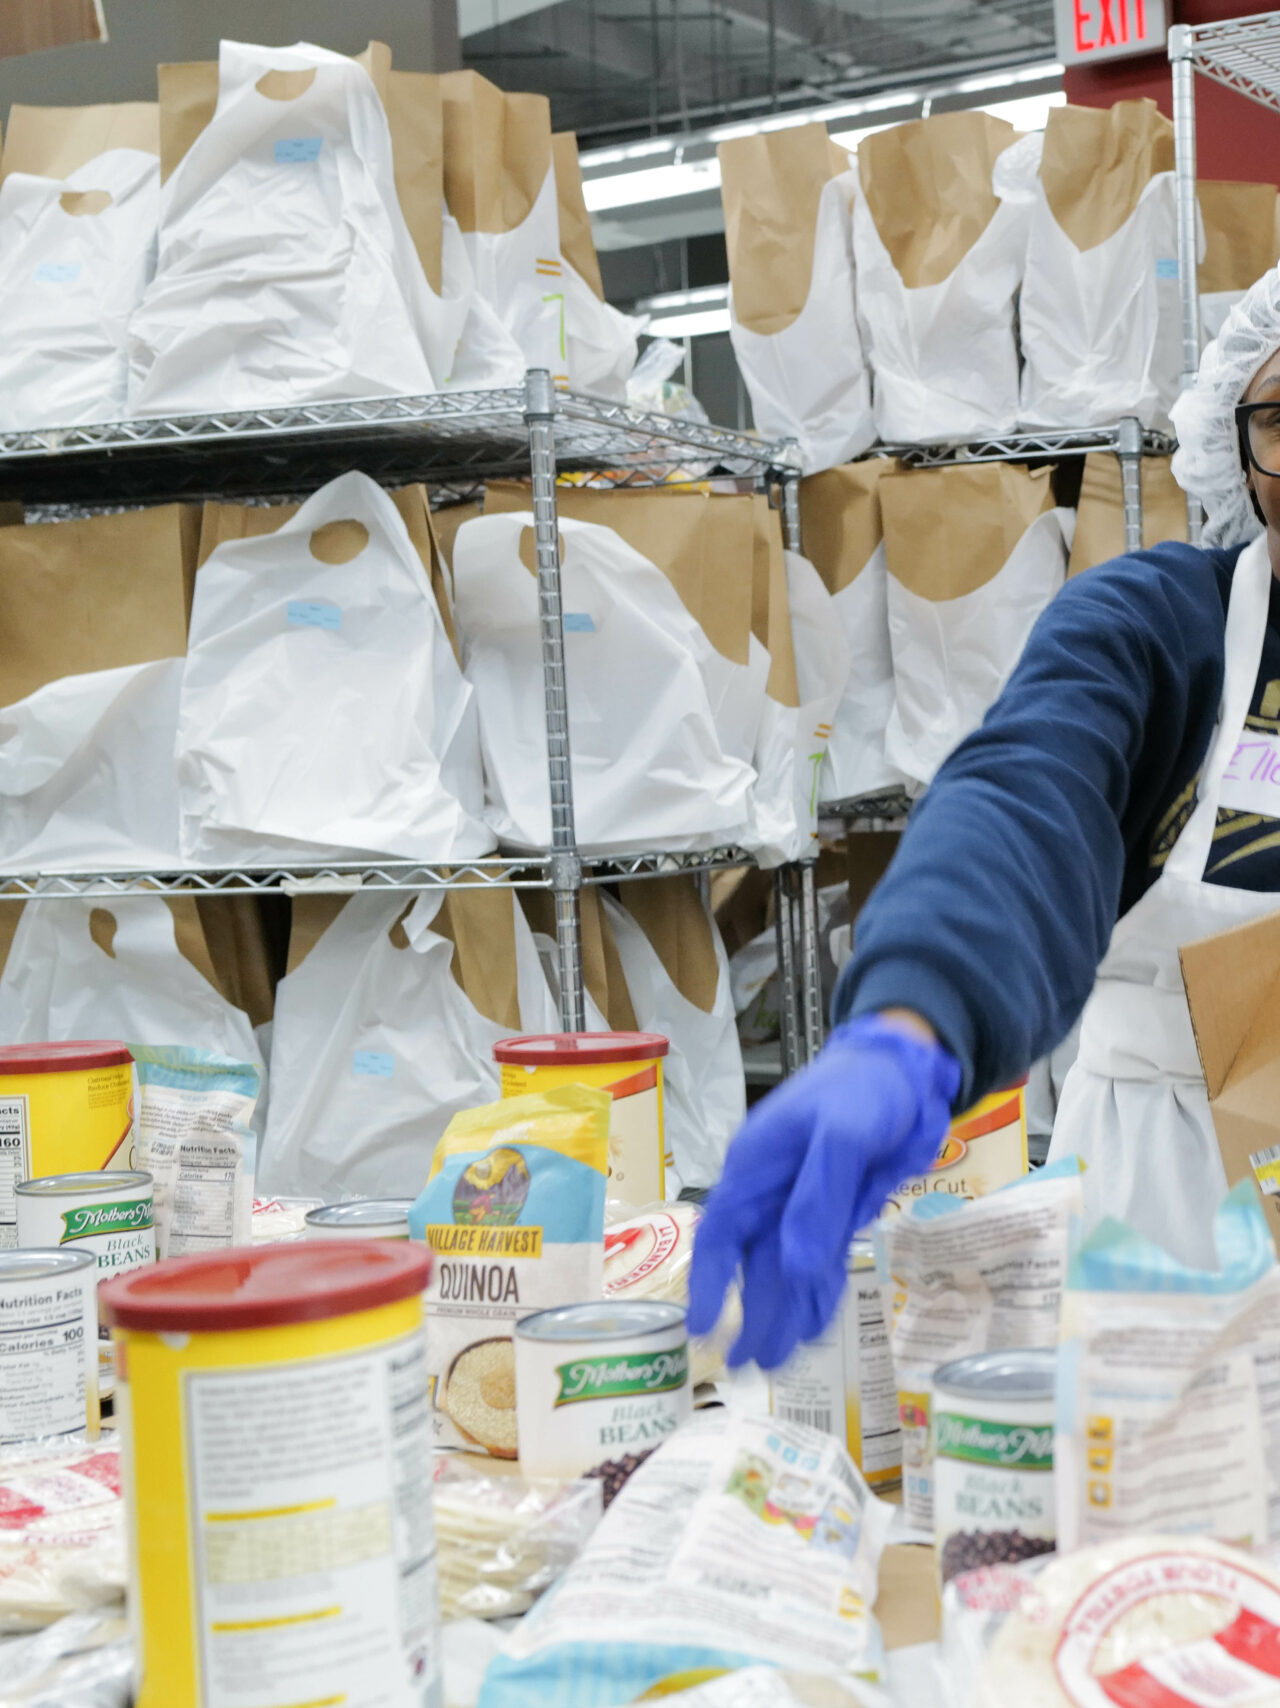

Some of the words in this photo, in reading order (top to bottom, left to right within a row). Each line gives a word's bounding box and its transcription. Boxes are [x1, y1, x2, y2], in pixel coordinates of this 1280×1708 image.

[933, 1178, 967, 1194] Cut
[69, 1207, 134, 1234] Mother's
[107, 1234, 143, 1251] Black
[427, 1227, 476, 1251] VILLAGE
[479, 1229, 540, 1254] HARVEST
[98, 1246, 150, 1268] BEANS
[56, 1287, 83, 1302] Facts
[439, 1263, 520, 1303] QUINOA
[63, 1326, 84, 1342] 100
[564, 1360, 654, 1396] Mother's
[599, 1414, 677, 1445] BEANS
